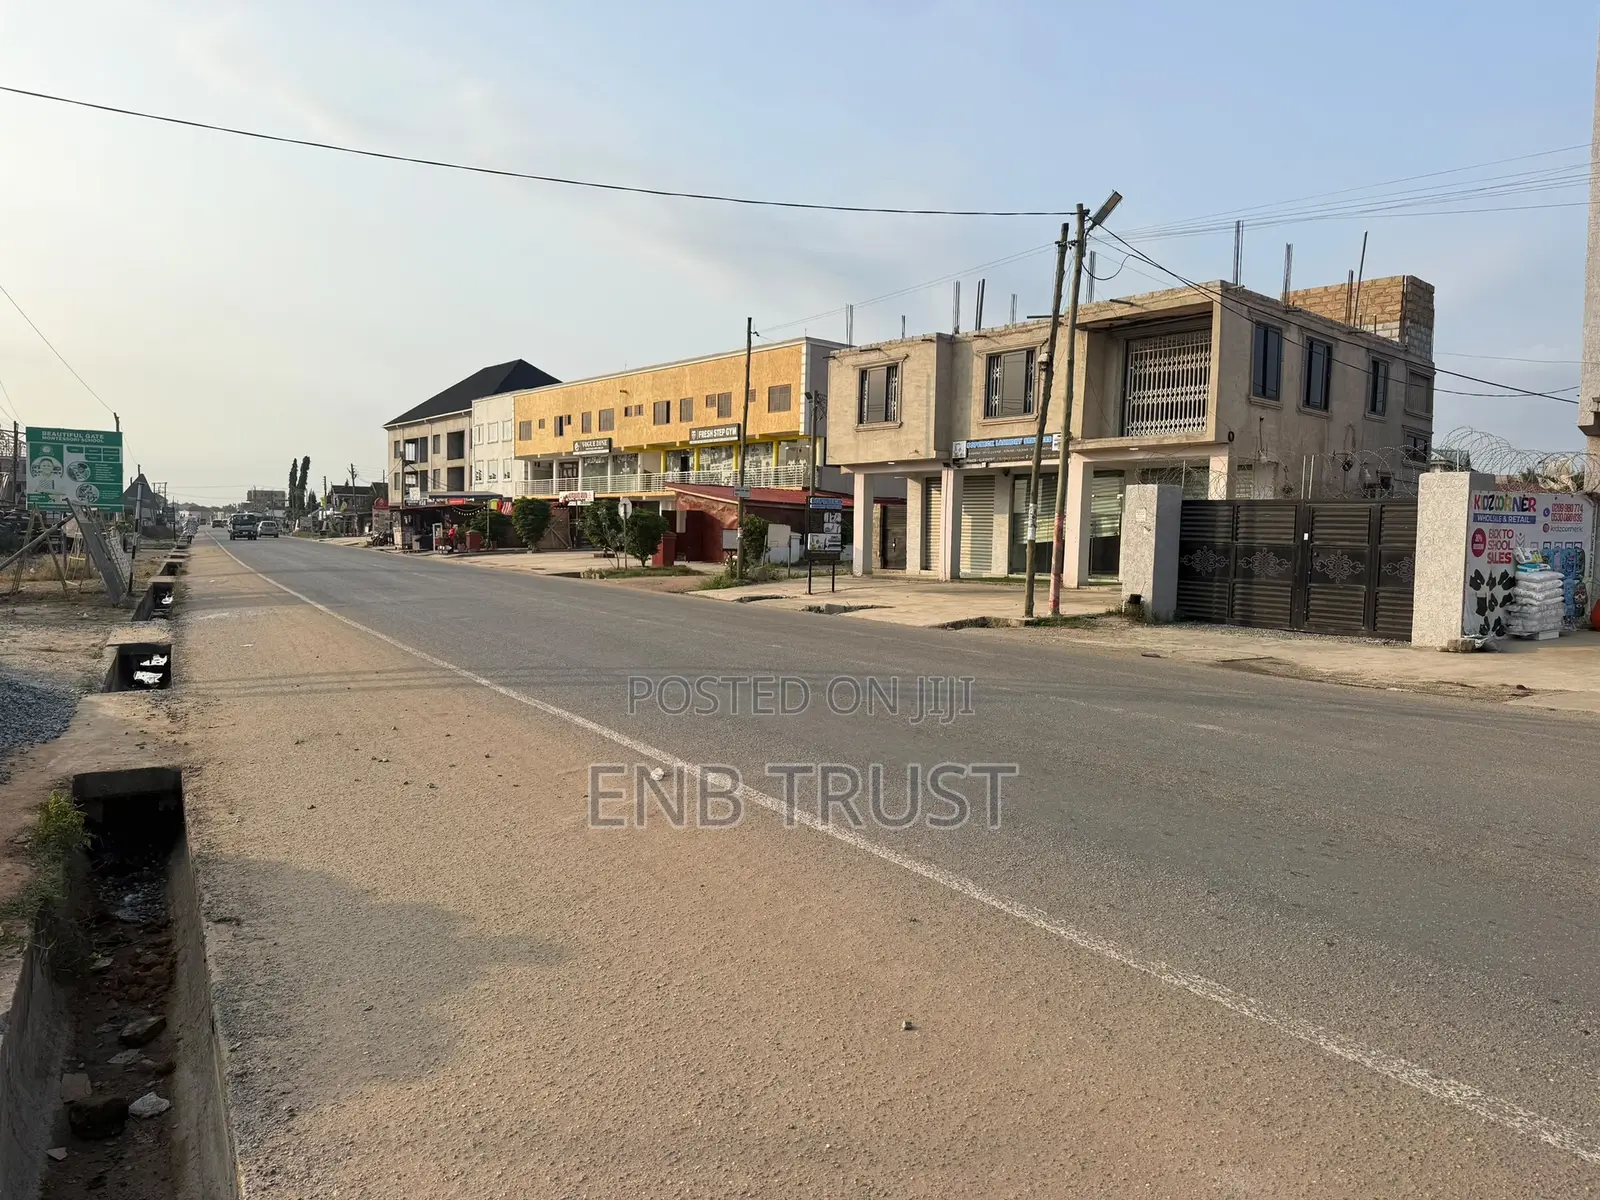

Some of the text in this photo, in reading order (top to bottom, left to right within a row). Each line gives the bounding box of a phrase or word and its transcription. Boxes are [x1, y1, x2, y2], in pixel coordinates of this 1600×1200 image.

[42, 430, 82, 438] BEAUTIFUL
[698, 426, 737, 439] FRESH STEP GYM
[1489, 529, 1514, 539] BACK TO
[1487, 552, 1512, 564] SALES
